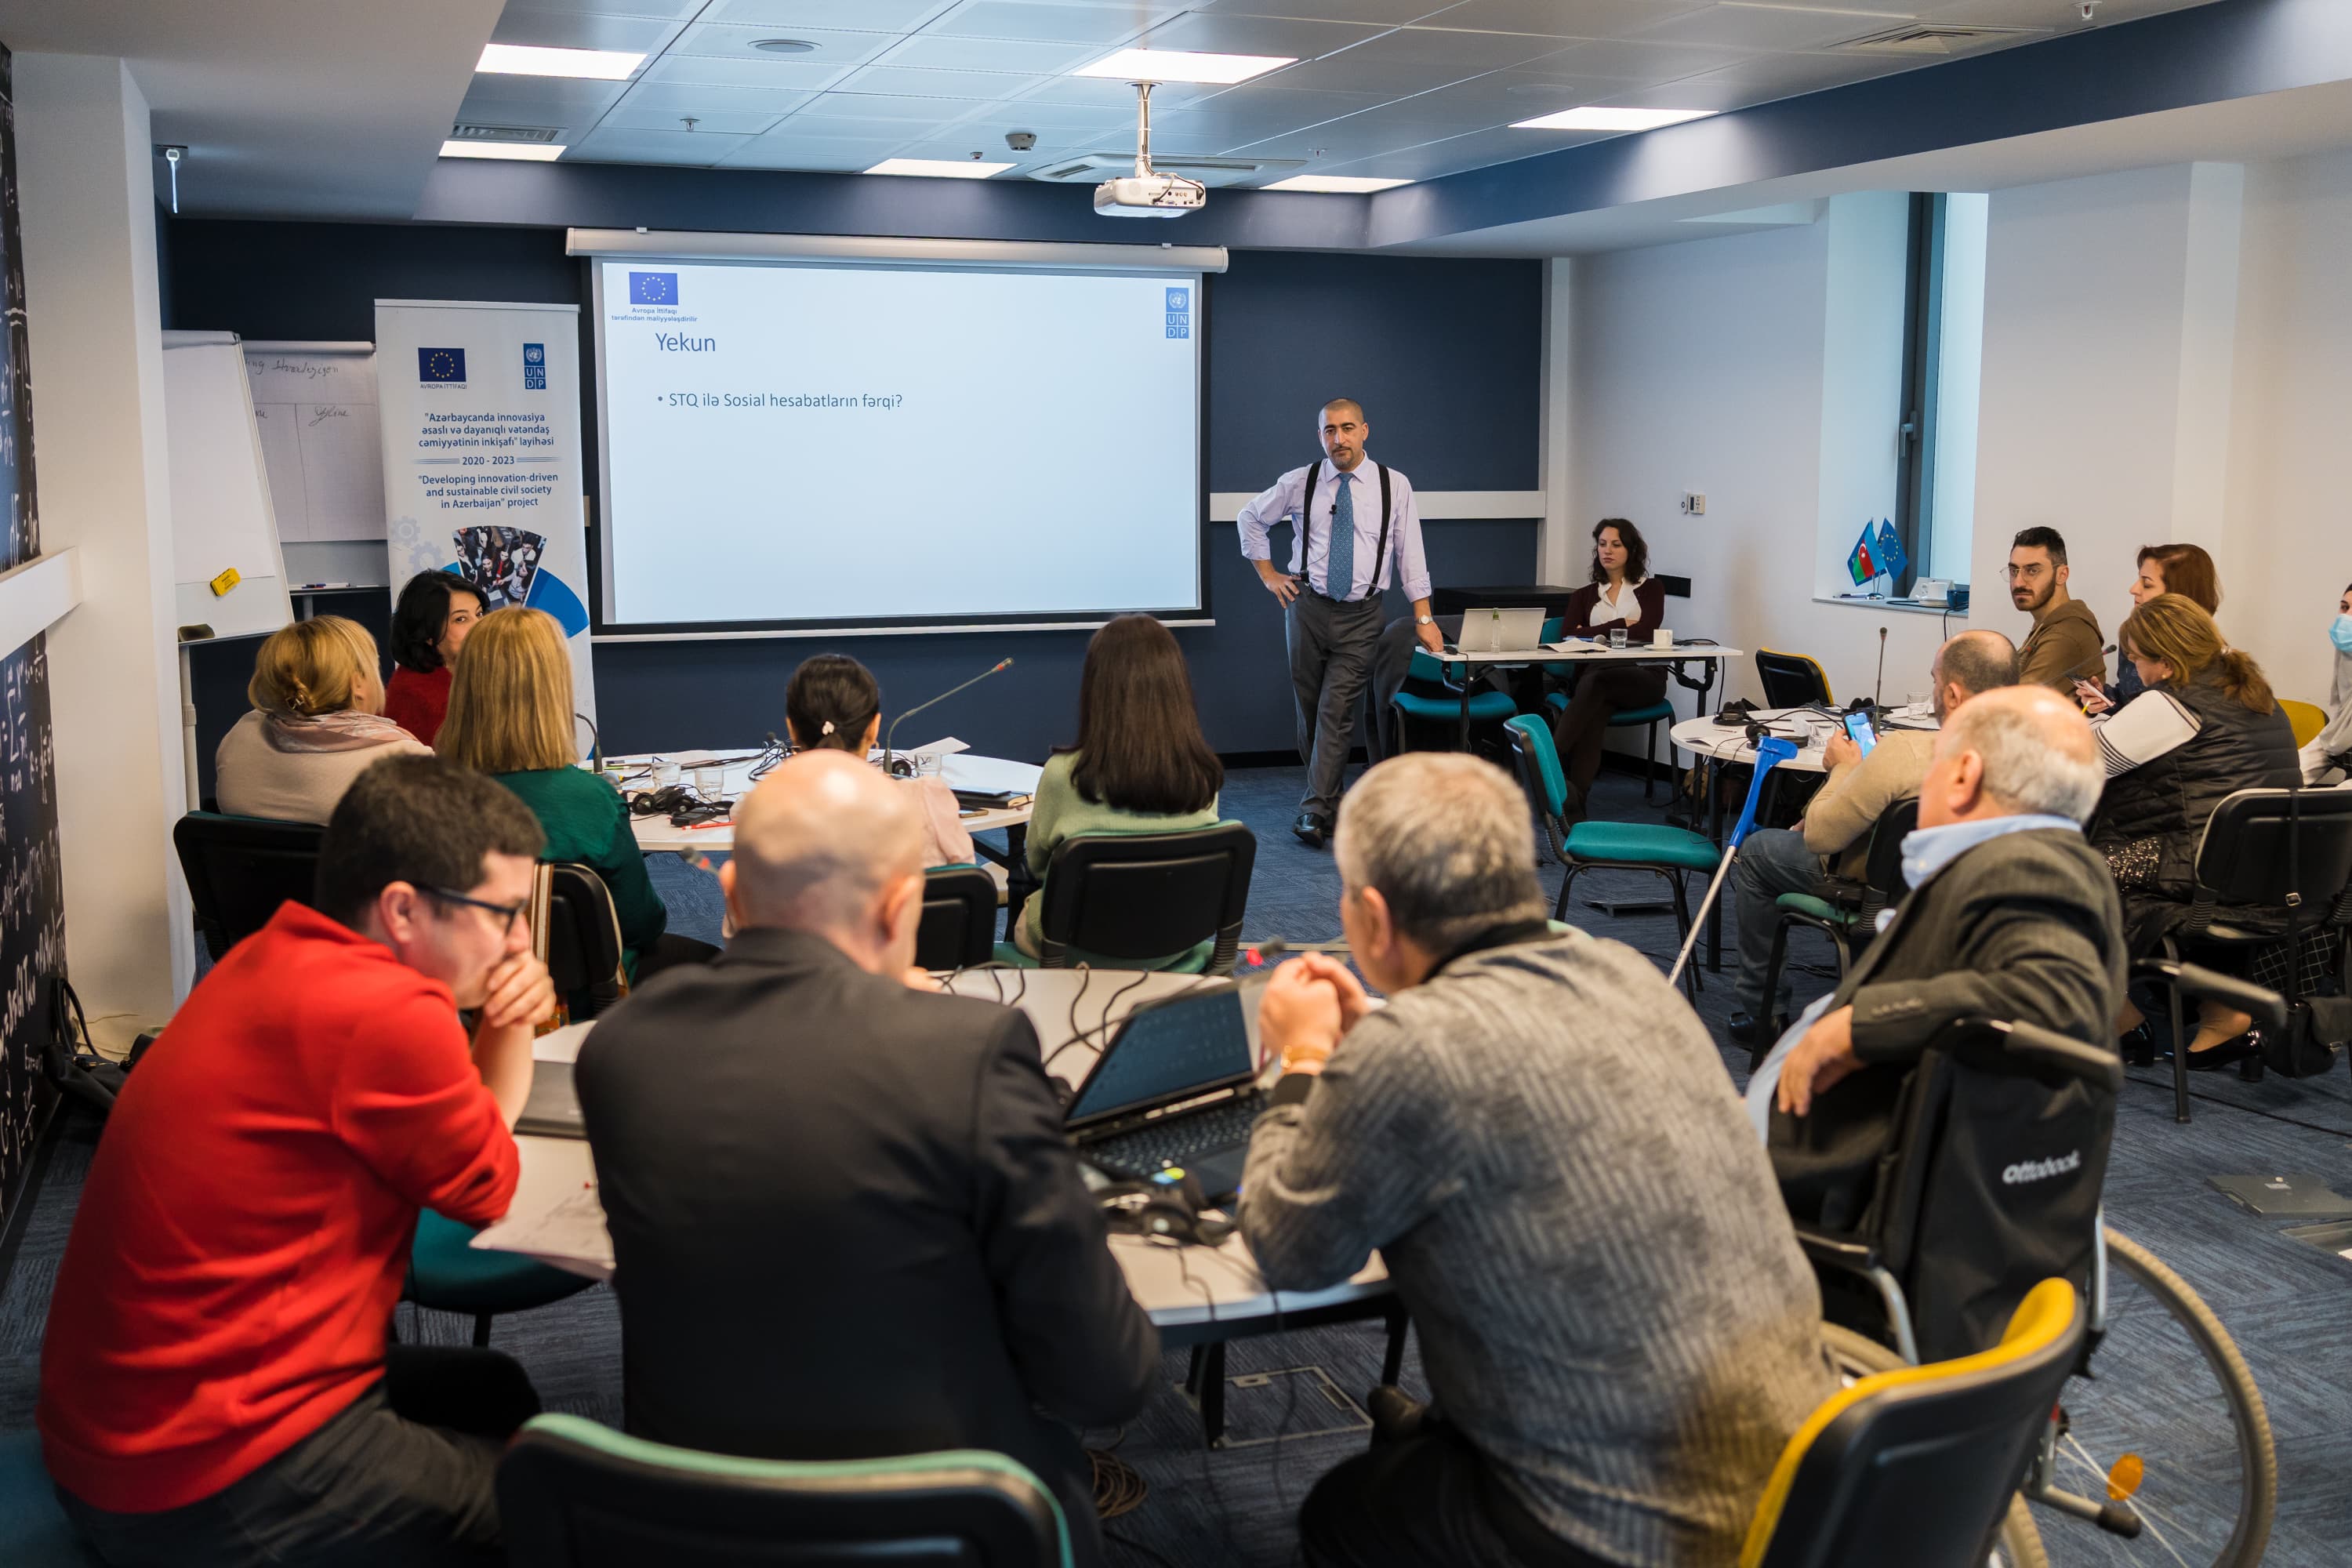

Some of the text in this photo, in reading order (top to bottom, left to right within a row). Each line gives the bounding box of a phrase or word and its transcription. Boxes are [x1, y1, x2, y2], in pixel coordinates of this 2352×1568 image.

[655, 332, 716, 352] Yekun
[670, 394, 903, 411] STQ ilə Sosial hesabatların fərqi?
[425, 412, 545, 424] "Azərbaycanda innovasiya
[422, 425, 448, 434] əsaslı
[463, 425, 506, 436] dayanıqlı
[508, 425, 550, 435] vətəndaş
[419, 436, 554, 449] cəmiyyətinin inkişafı" layihəsi
[462, 456, 485, 466] 2020
[492, 456, 515, 465] 2023
[418, 473, 558, 485] "Developing innovation-driven
[426, 485, 552, 496] and sustainable civil society
[441, 498, 539, 510] in Azerbaijan" project
